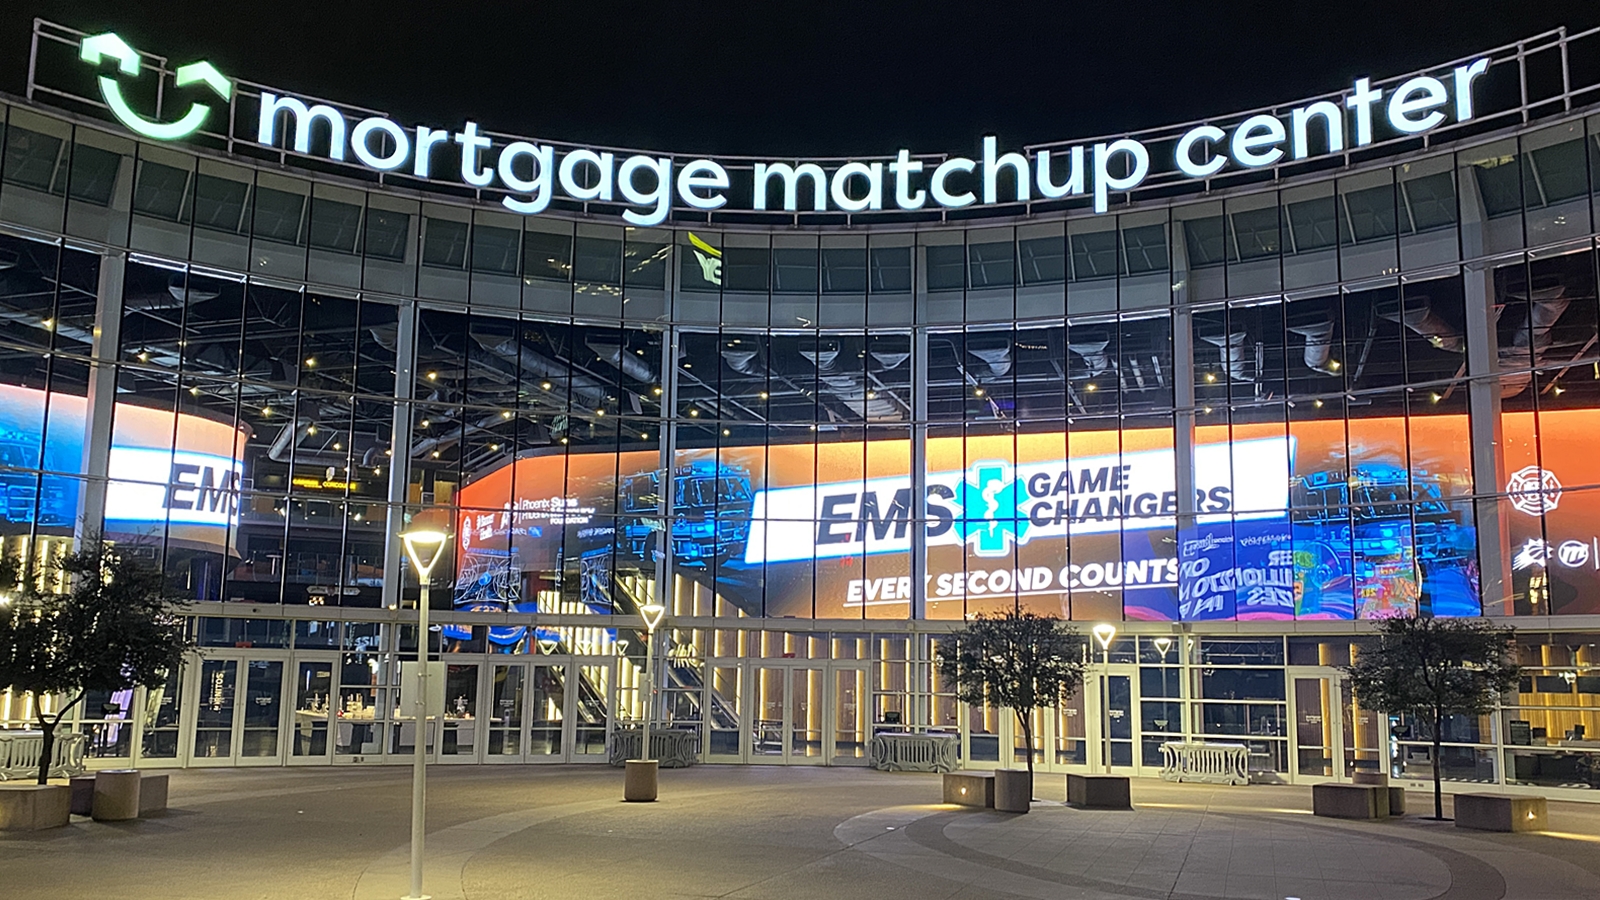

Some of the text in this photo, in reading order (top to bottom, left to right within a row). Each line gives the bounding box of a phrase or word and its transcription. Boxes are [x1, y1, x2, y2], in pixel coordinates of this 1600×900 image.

[257, 57, 1491, 226] mortgage matchup center
[1028, 465, 1131, 498] GAME
[816, 484, 955, 545] EMS
[847, 557, 1178, 603] EVER SECOND COUNTS
